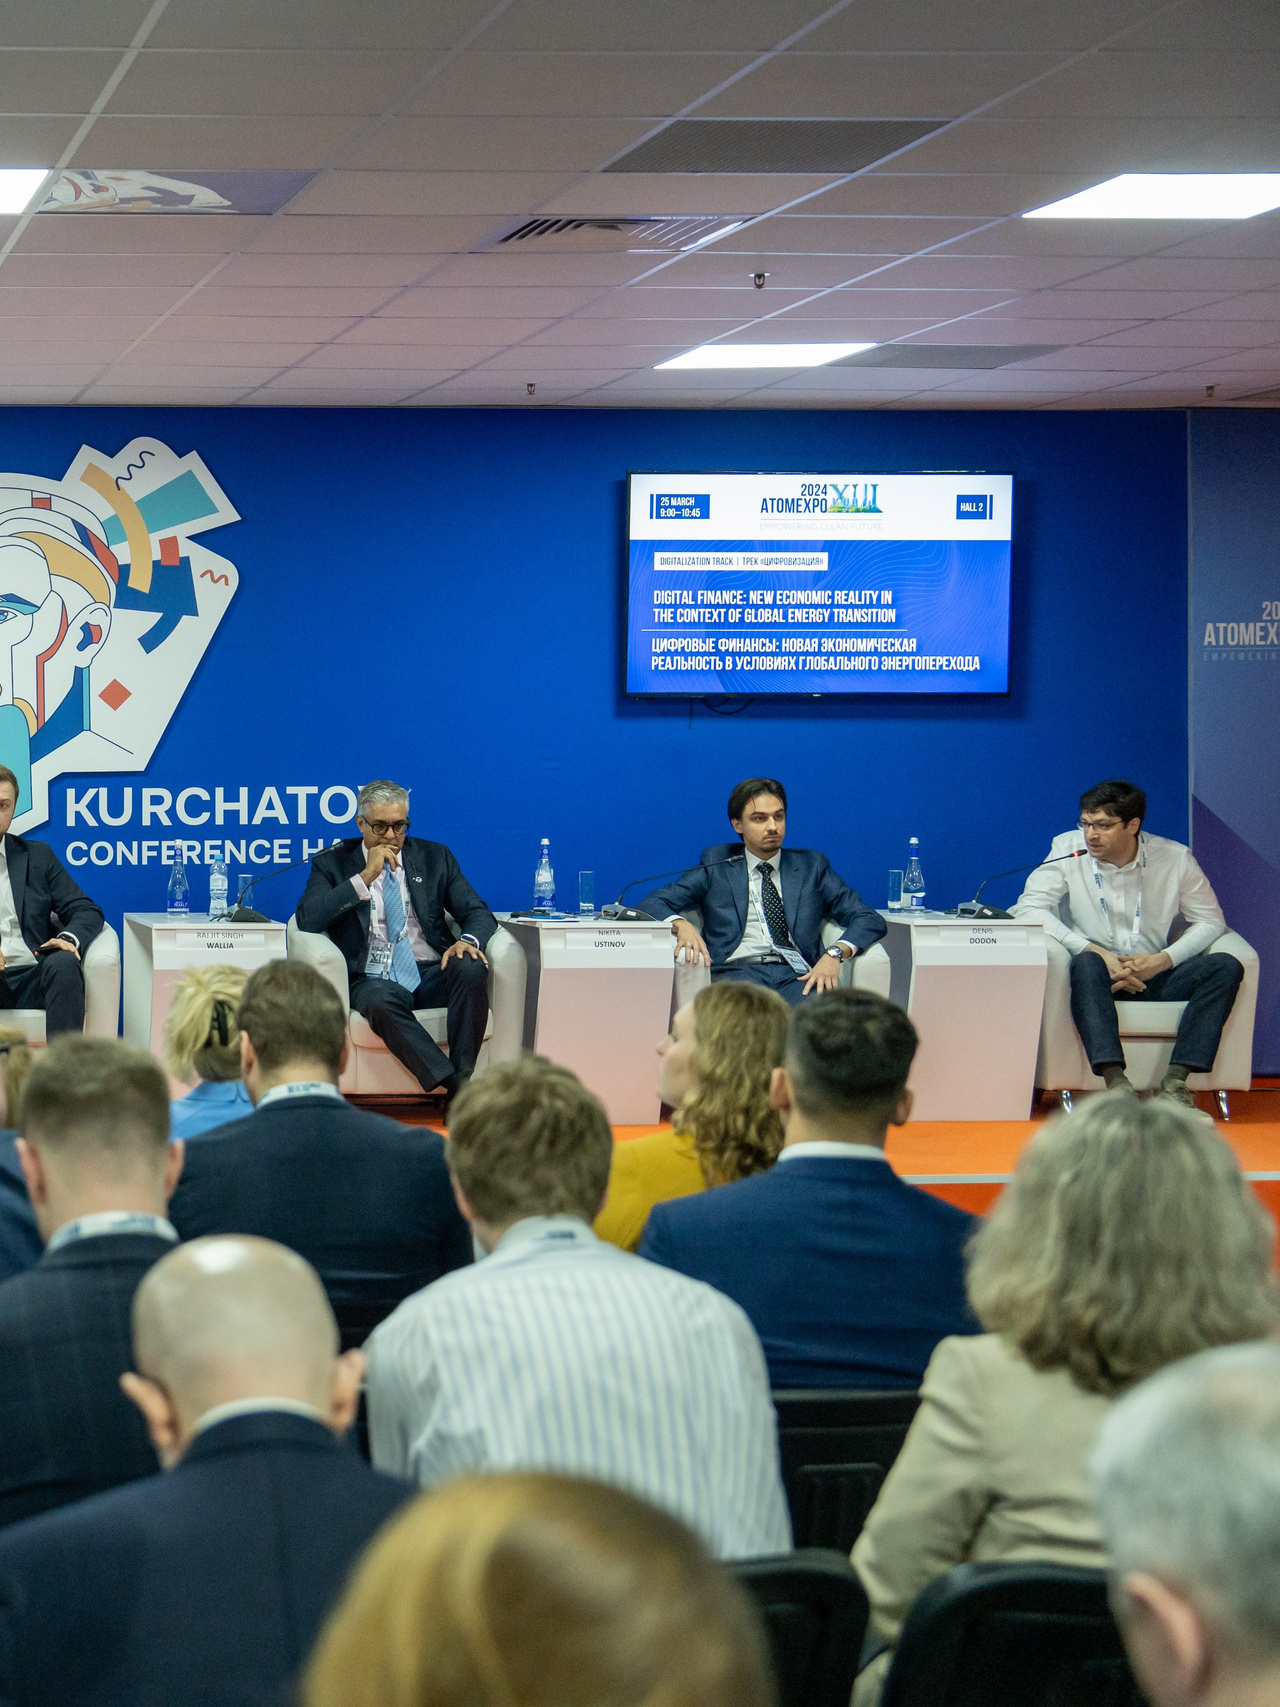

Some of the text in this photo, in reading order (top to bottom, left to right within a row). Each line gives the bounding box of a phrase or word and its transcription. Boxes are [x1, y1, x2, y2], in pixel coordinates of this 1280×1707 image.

[801, 484, 828, 497] 2024
[660, 497, 695, 506] 25 MARCH
[760, 498, 828, 513] ATOMEXPO
[960, 503, 984, 512] HALL 2
[760, 523, 883, 531] EMPOWERING CLEAN FUTURE
[660, 557, 734, 566] DIGITALIZATION TRACK
[742, 557, 759, 566] ТРЕК
[653, 590, 892, 605] DIGITAL FINANCE: NEW ECONOMIC REALITY IN
[653, 608, 896, 623] THE CONTEXT OF GLOBAL ENERGY TRANSITION
[1204, 622, 1280, 646] ATOMEX
[652, 638, 917, 653] ЦИФРОВЫЕ ФИНАНСЫ: НОВАЯ ЭКОНОМИЧЕСКАЯ
[651, 656, 980, 671] РЕАЛЬНОСТЬ В УСЛОВИЯХ ГЛОБАЛЬНОГО ЭНЕРГОПЕРЕХОДА
[66, 785, 412, 827] KURCHATO
[66, 838, 291, 866] CONFERENCE
